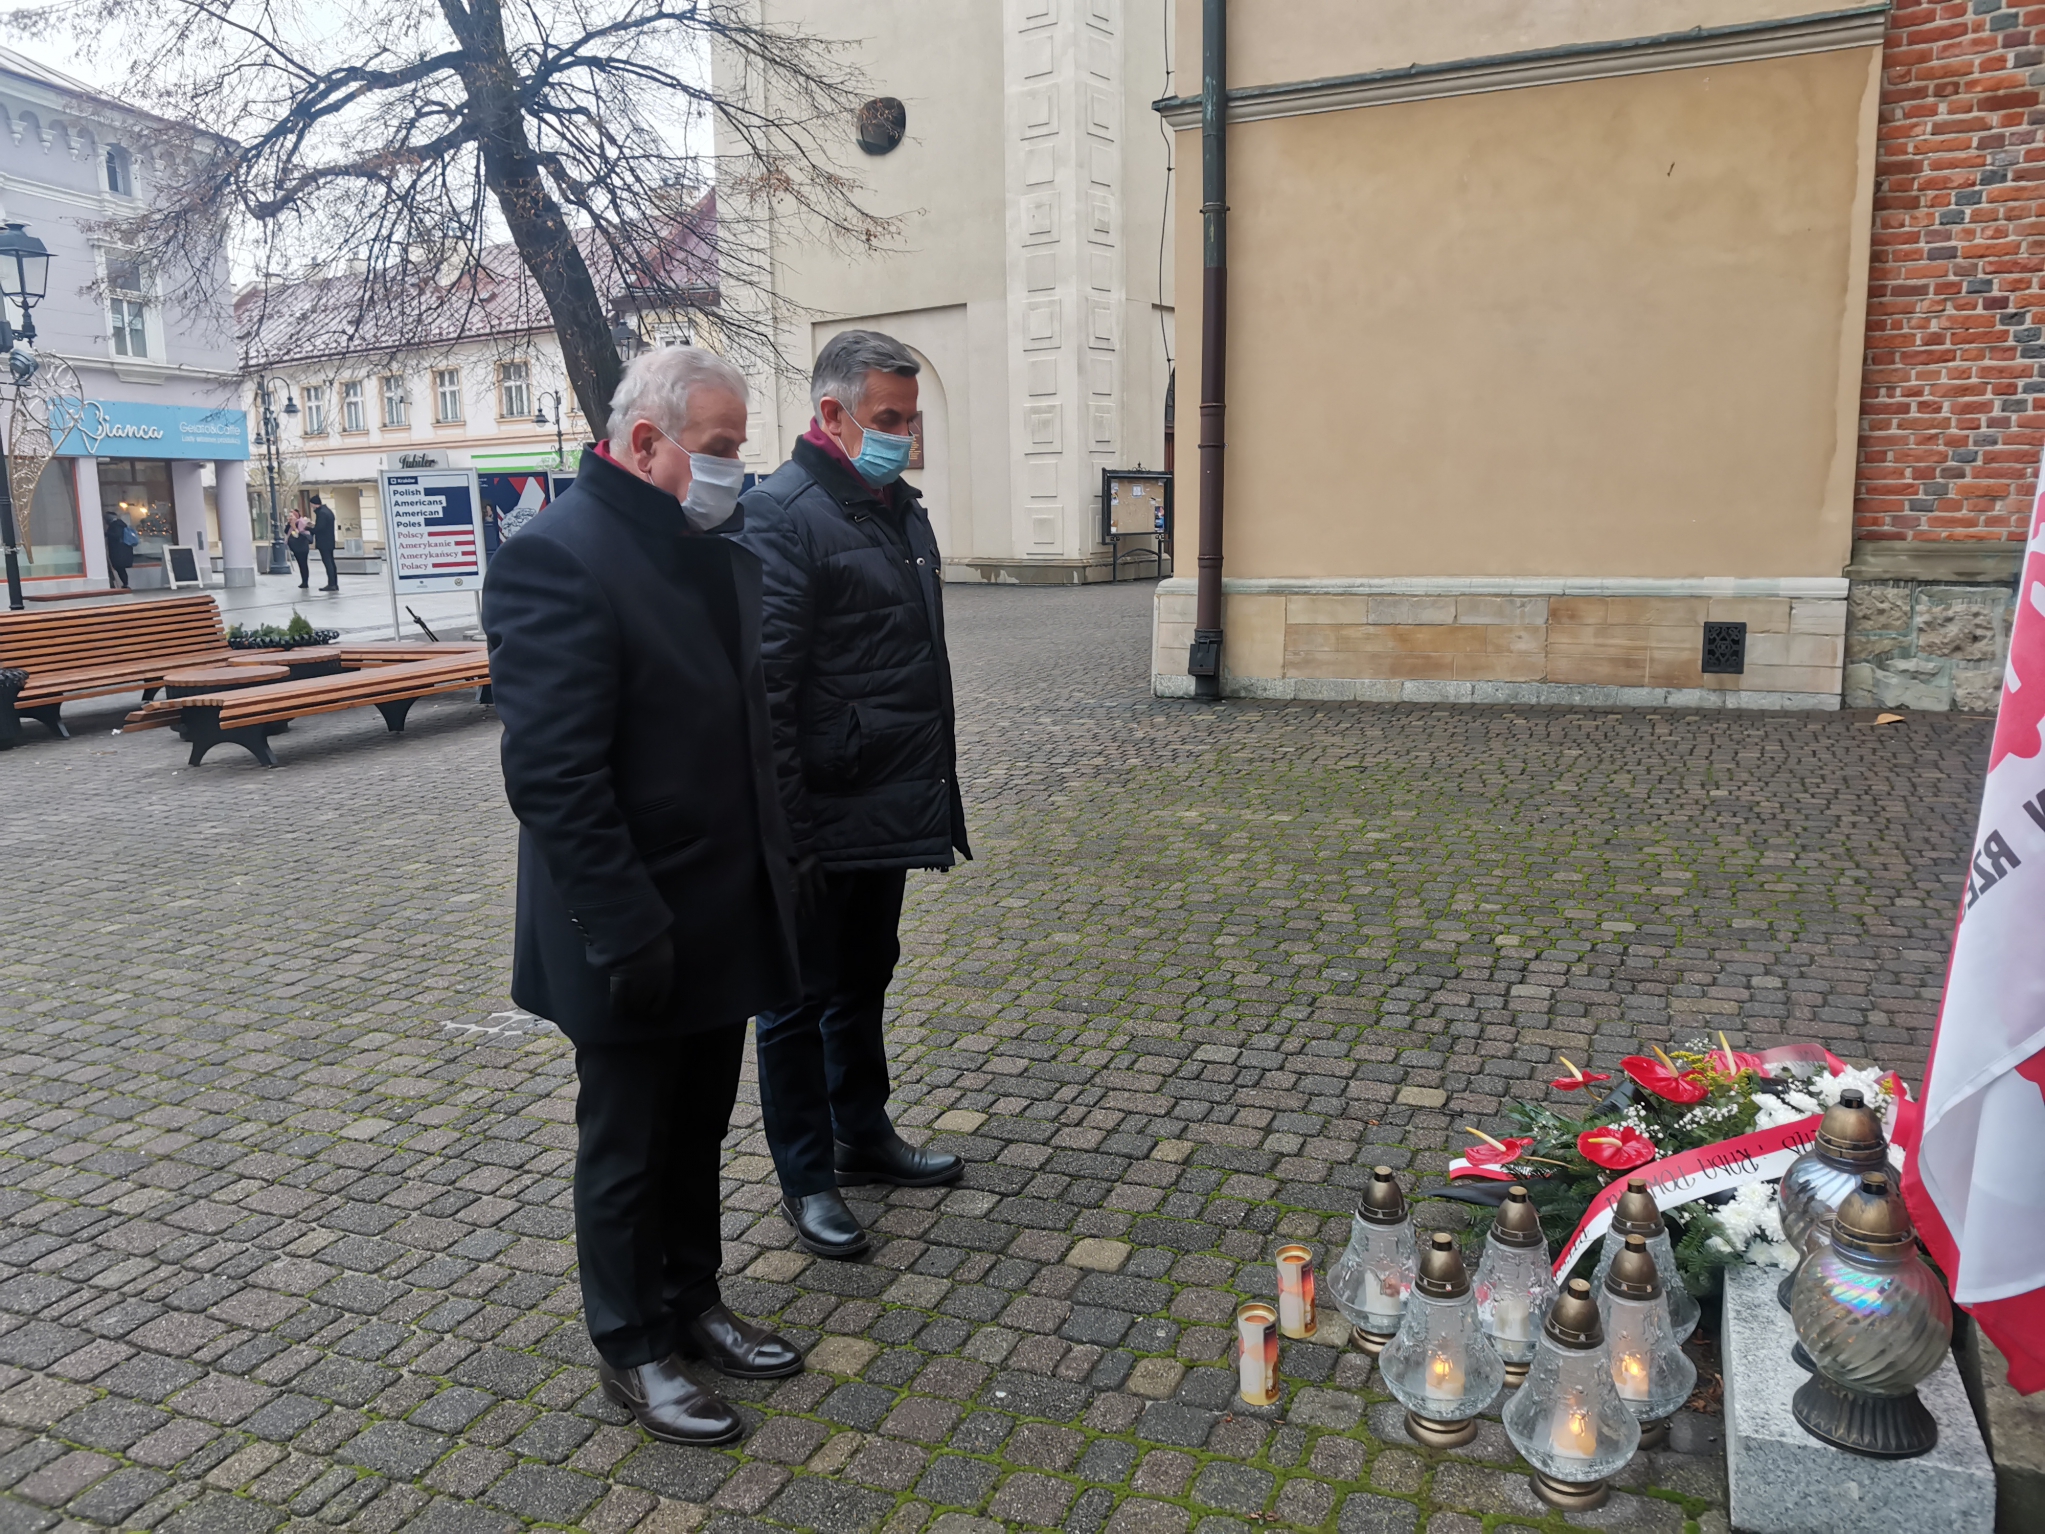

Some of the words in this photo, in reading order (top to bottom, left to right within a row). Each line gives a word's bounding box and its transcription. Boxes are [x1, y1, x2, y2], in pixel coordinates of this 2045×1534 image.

[78, 401, 164, 440] Bianca
[393, 488, 421, 496] Polish
[394, 499, 443, 507] Americans
[395, 510, 439, 518] American
[397, 531, 424, 539] Polscy
[398, 540, 452, 550] Amerykanie
[399, 550, 459, 560] Amerykańscy
